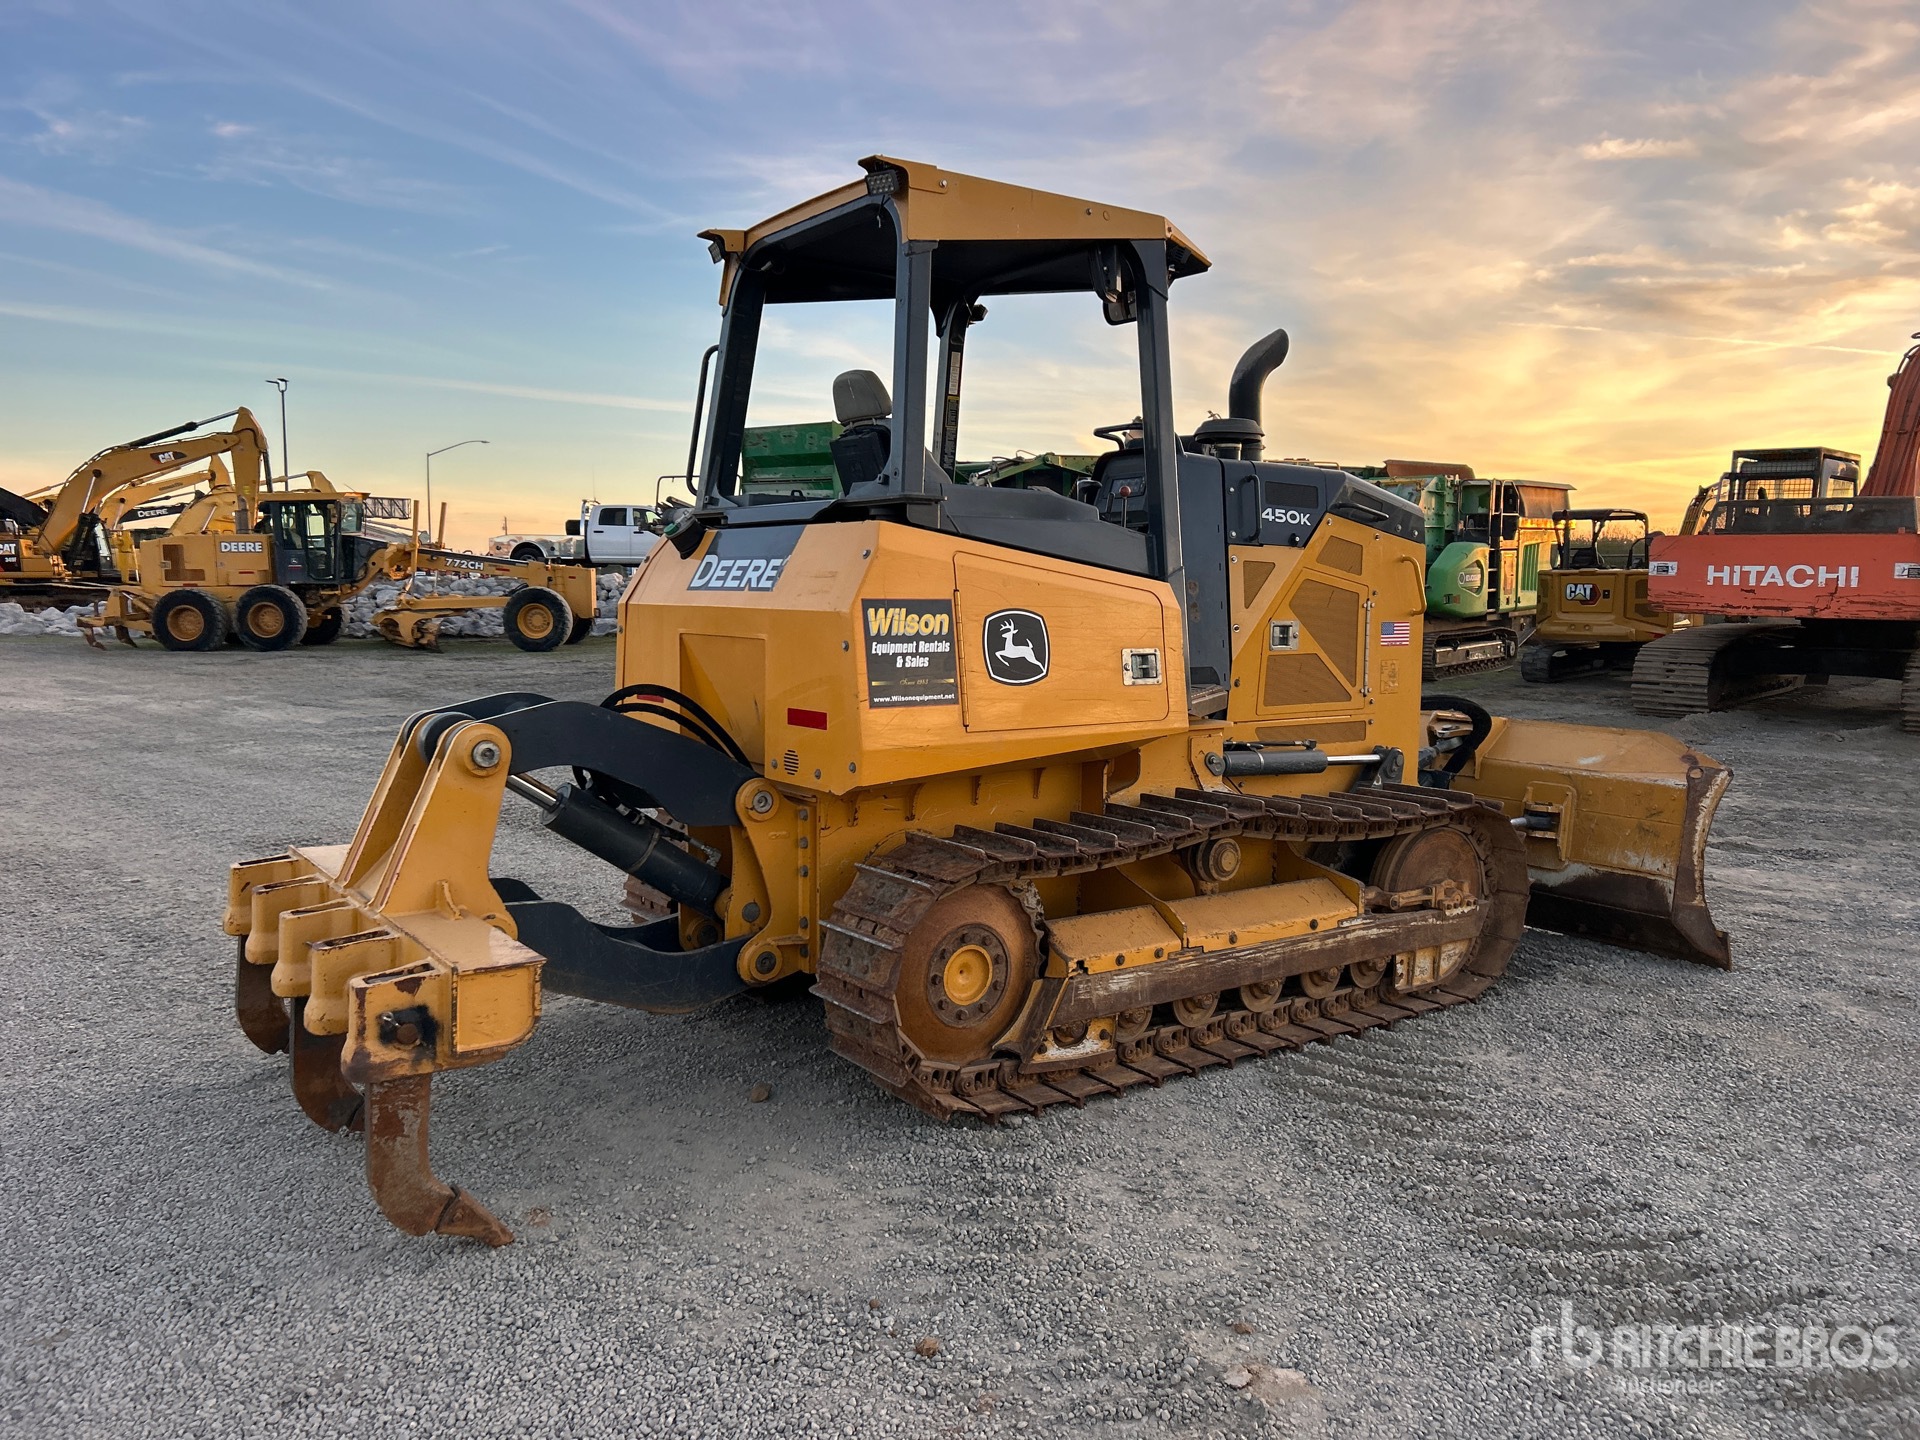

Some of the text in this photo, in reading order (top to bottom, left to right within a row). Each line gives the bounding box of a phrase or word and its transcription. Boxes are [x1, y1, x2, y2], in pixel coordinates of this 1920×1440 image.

[158, 451, 175, 463] CAT
[138, 508, 169, 518] DEERE
[1261, 507, 1311, 526] 450K
[220, 542, 262, 552] DEERE
[445, 558, 484, 571] 772CH
[690, 554, 783, 588] DEERE
[1706, 564, 1860, 588] HITACHI
[1566, 583, 1593, 601] CAT
[867, 607, 950, 637] Wilson
[871, 640, 951, 656] Equipment Rentals
[896, 655, 930, 668] & Sales
[873, 693, 955, 703] www.Wilsonequipment.net
